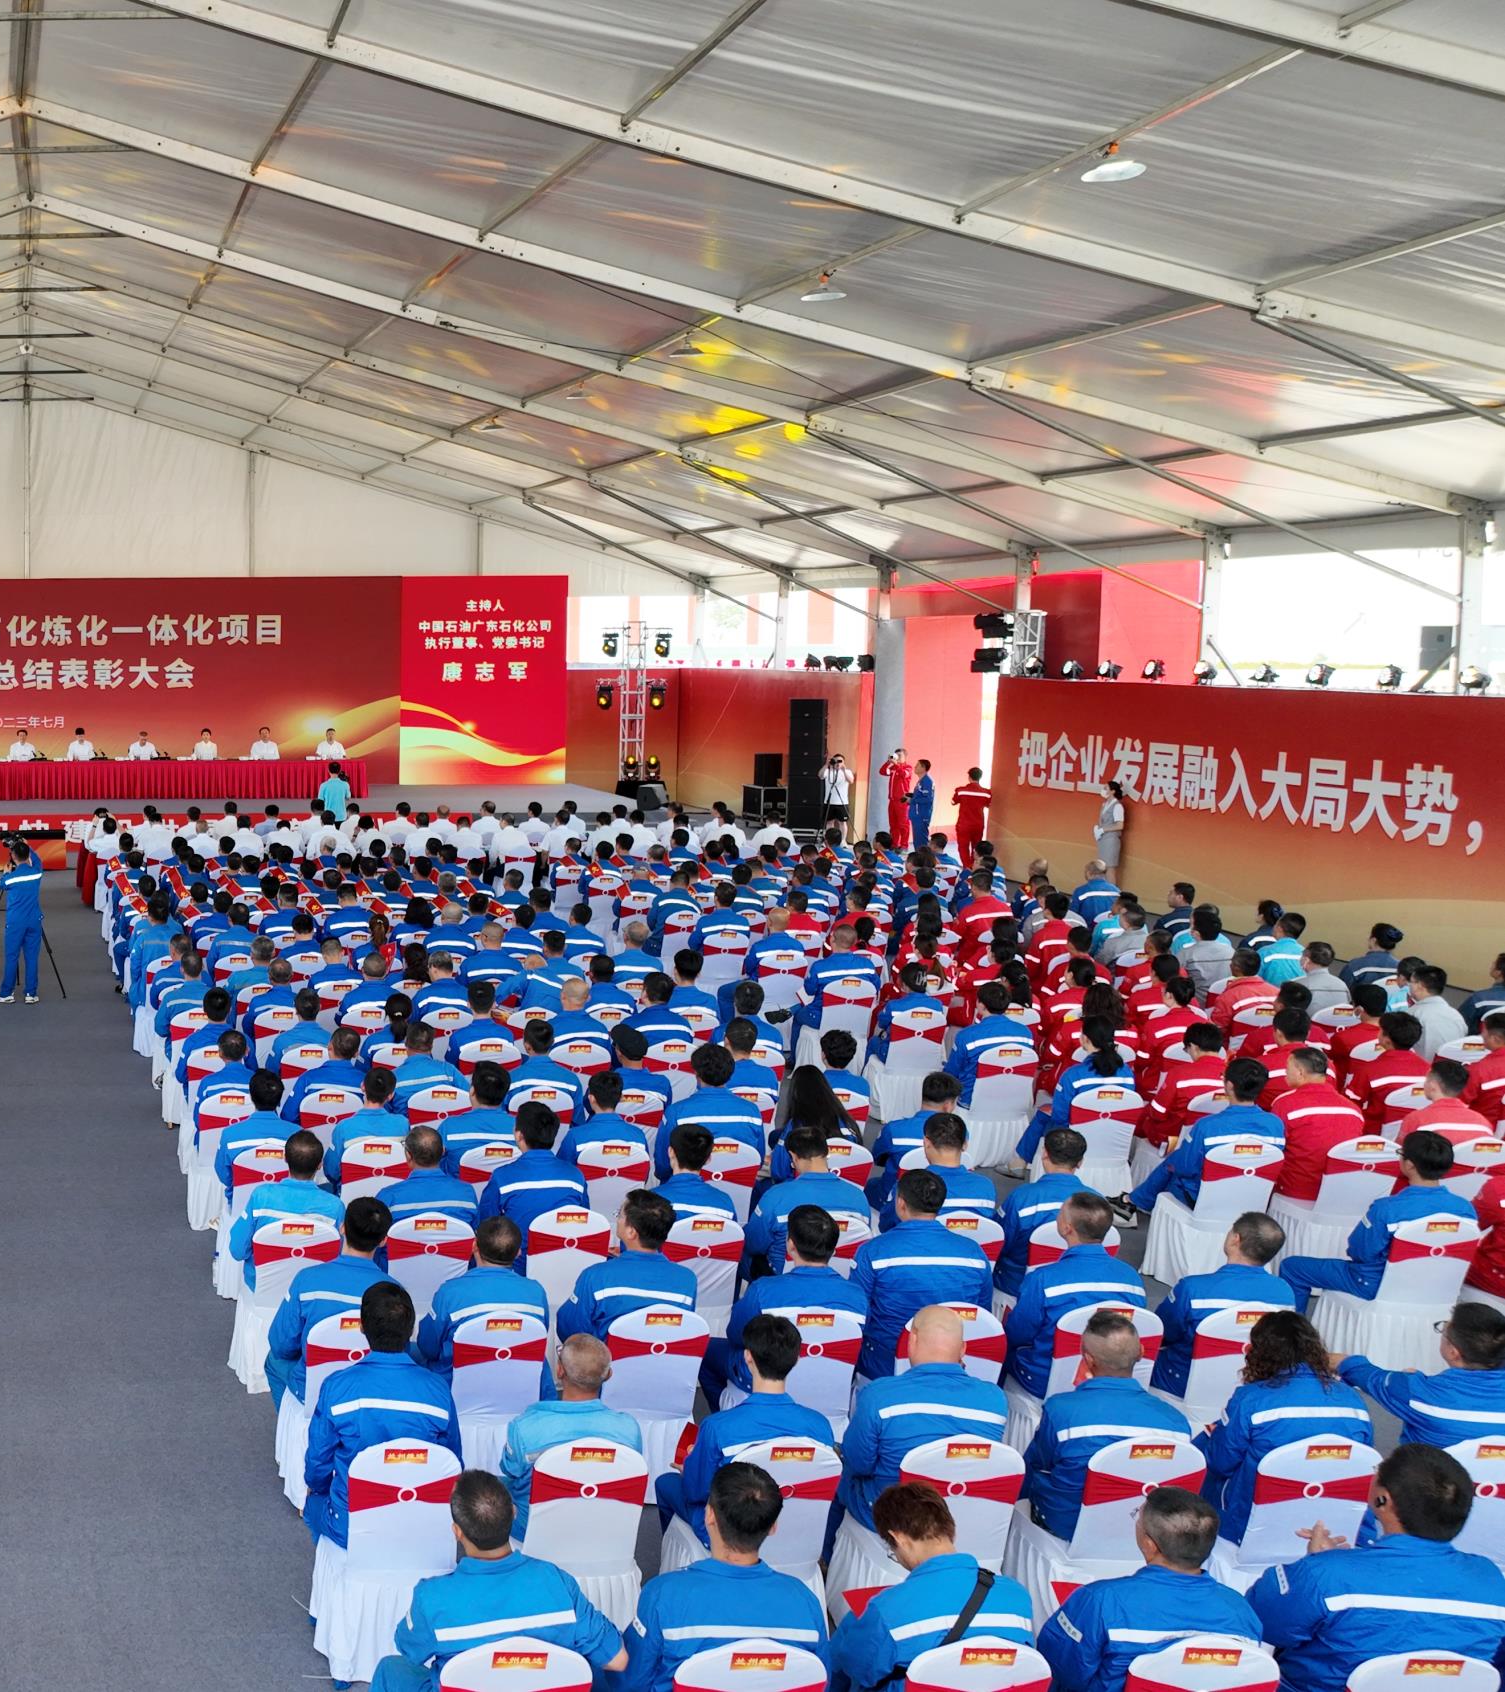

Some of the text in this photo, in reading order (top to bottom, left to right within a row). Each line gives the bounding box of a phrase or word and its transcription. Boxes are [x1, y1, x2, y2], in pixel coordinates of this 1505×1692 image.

[466, 599, 505, 612] 主持人
[418, 619, 552, 633] 中国石油广东石化公司
[424, 636, 545, 650] 执行董事、党委书记
[441, 661, 528, 683] 康志军
